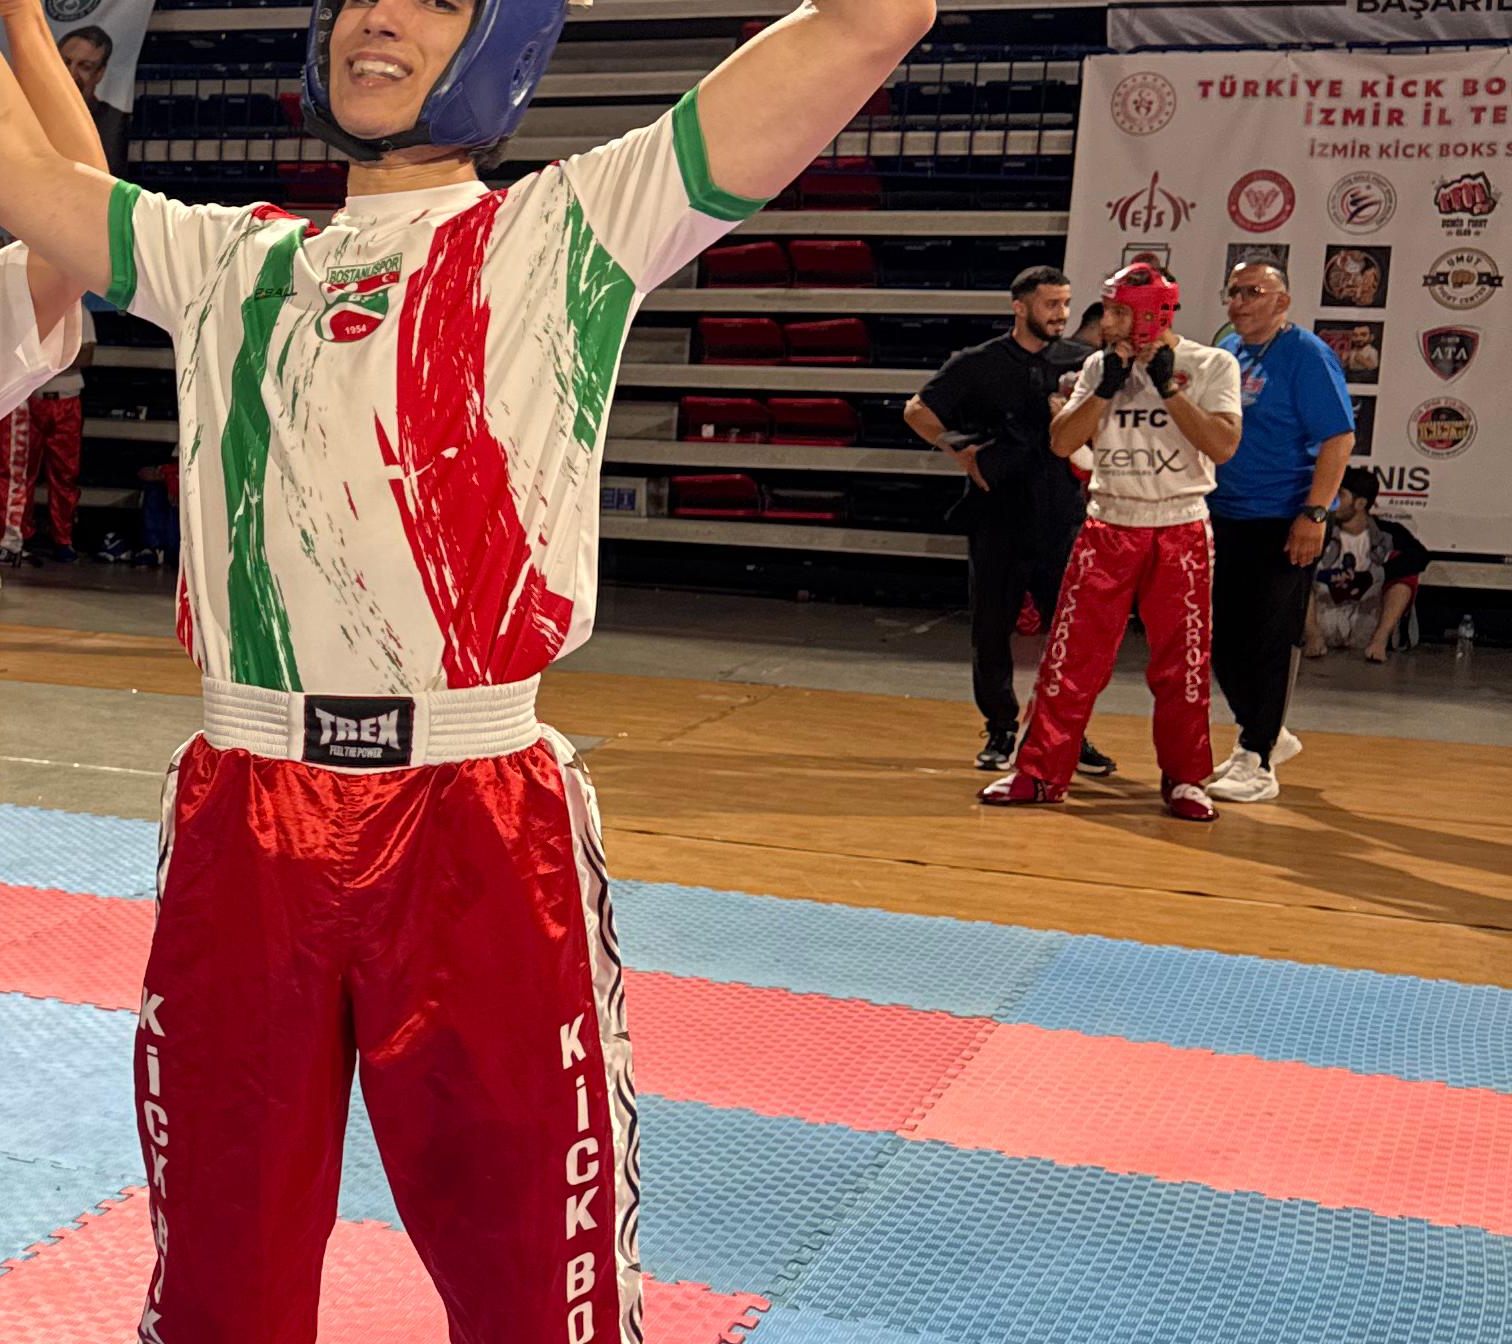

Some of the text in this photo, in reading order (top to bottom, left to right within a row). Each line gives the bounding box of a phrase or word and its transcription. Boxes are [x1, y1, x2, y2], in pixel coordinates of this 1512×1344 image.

[1197, 74, 1343, 99] TÜRKİYE
[1303, 102, 1405, 127] İZMİR
[1422, 102, 1452, 126] İL
[1309, 139, 1371, 159] İZMİR
[1378, 139, 1432, 159] KİCK
[1438, 140, 1498, 159] BOKS
[344, 323, 368, 336] 1954
[1114, 408, 1169, 429] TFC
[314, 707, 402, 751] TREX
[357, 746, 384, 759] POWER
